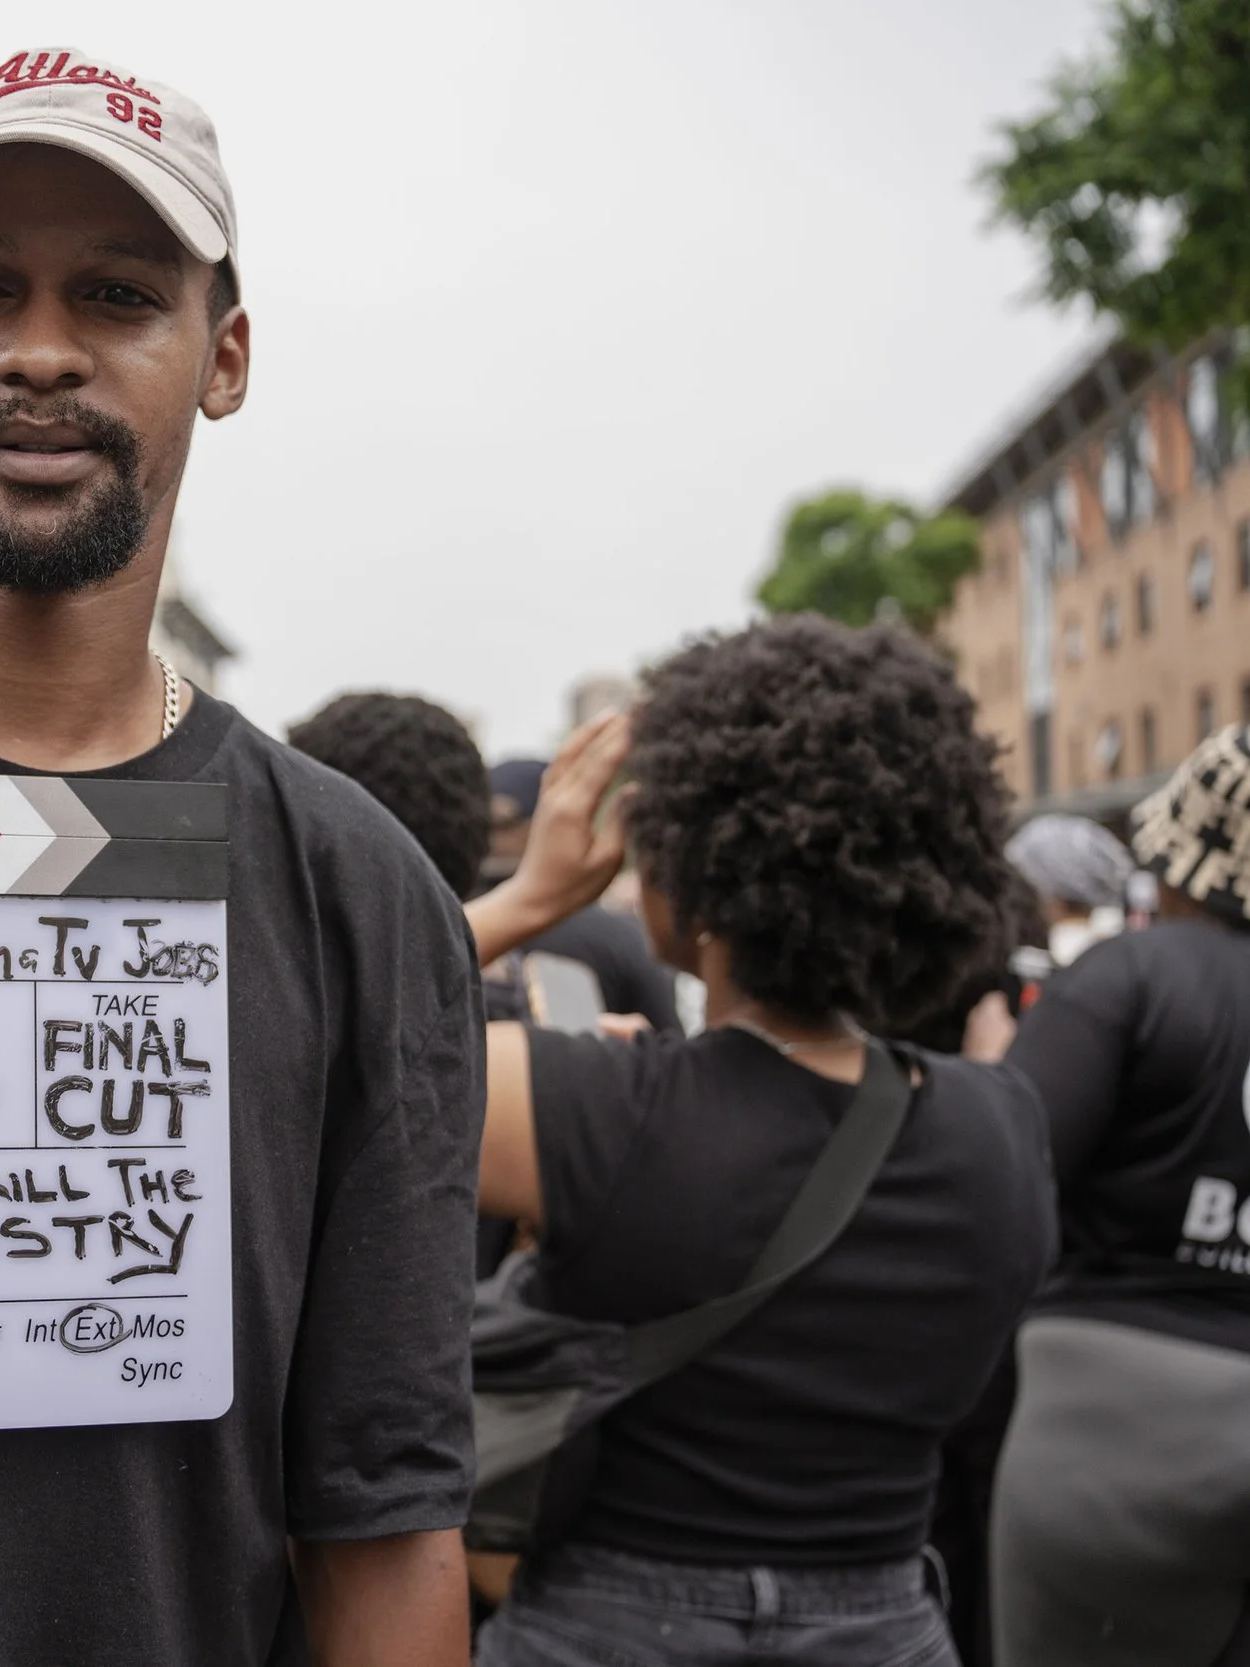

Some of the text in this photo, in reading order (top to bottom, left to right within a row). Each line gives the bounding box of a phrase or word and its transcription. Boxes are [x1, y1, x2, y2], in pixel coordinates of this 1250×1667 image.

[107, 93, 162, 142] 92
[92, 994, 159, 1017] TAKE
[43, 1018, 211, 1078] FINAL
[44, 1074, 211, 1141] CUT
[26, 1318, 58, 1344] Int
[75, 1316, 118, 1342] Ext
[133, 1314, 185, 1339] Mos
[121, 1357, 183, 1388] Sync
